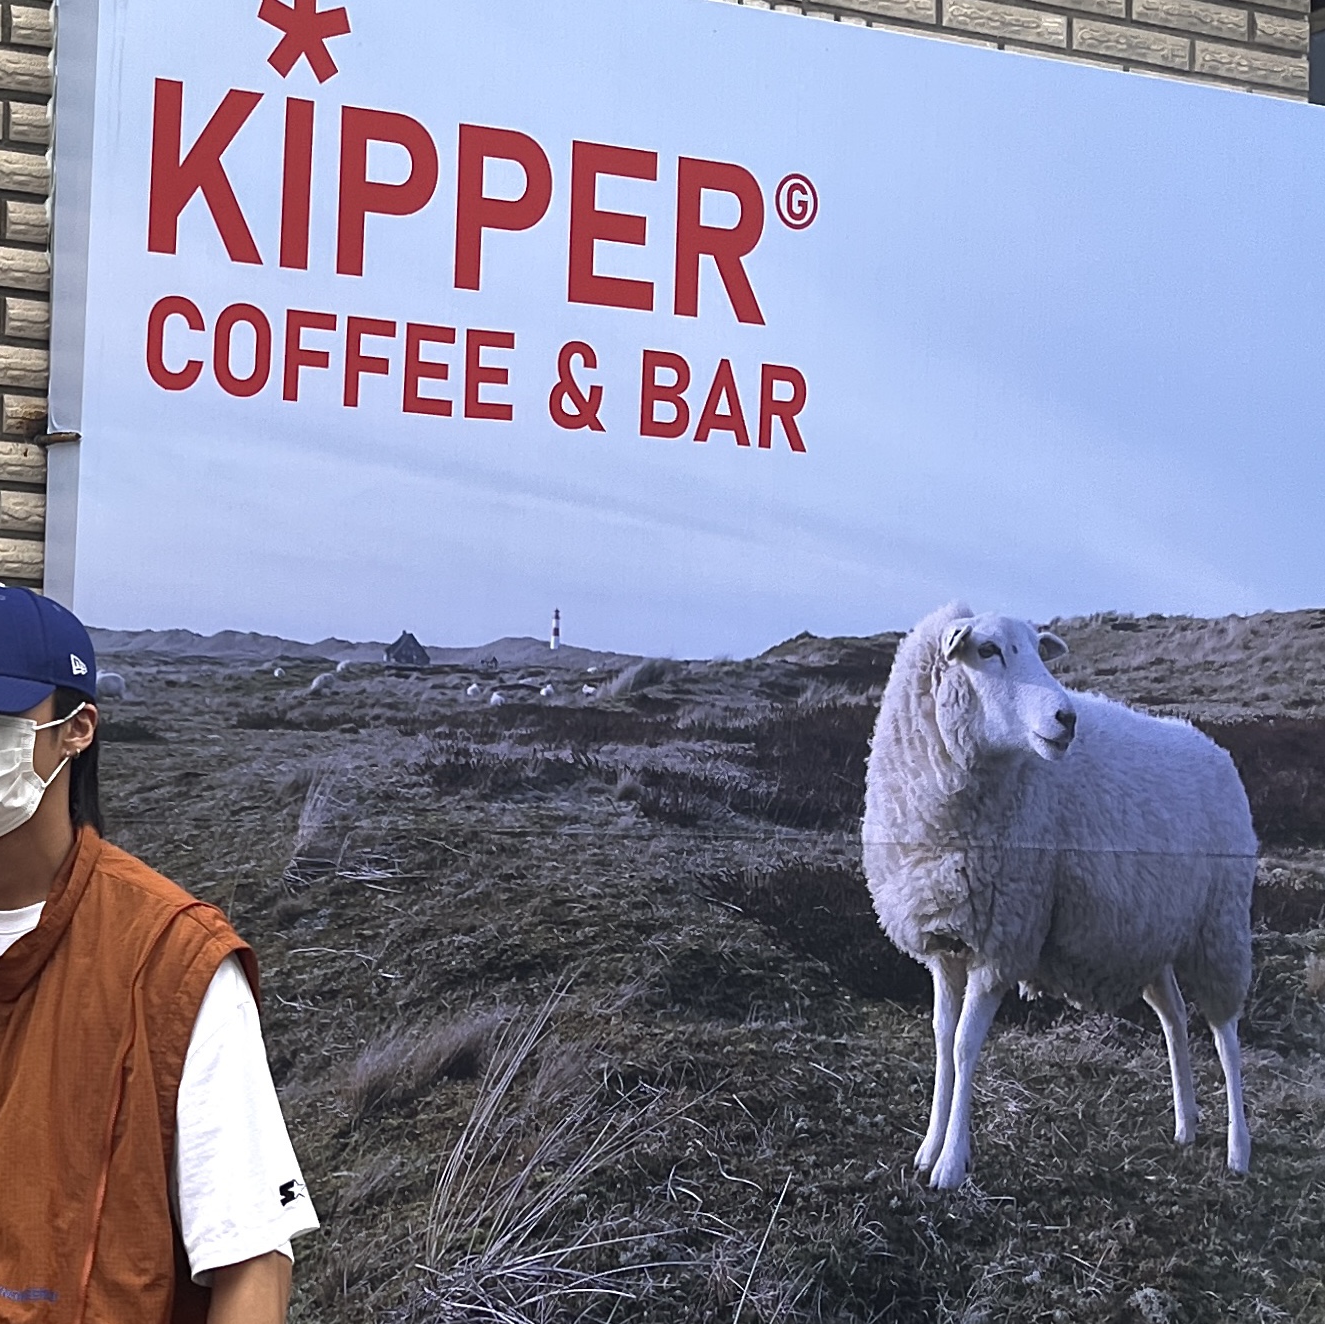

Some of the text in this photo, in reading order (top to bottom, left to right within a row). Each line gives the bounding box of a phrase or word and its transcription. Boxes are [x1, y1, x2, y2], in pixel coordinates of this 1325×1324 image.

[145, 294, 809, 453] COFFEE & BAR
